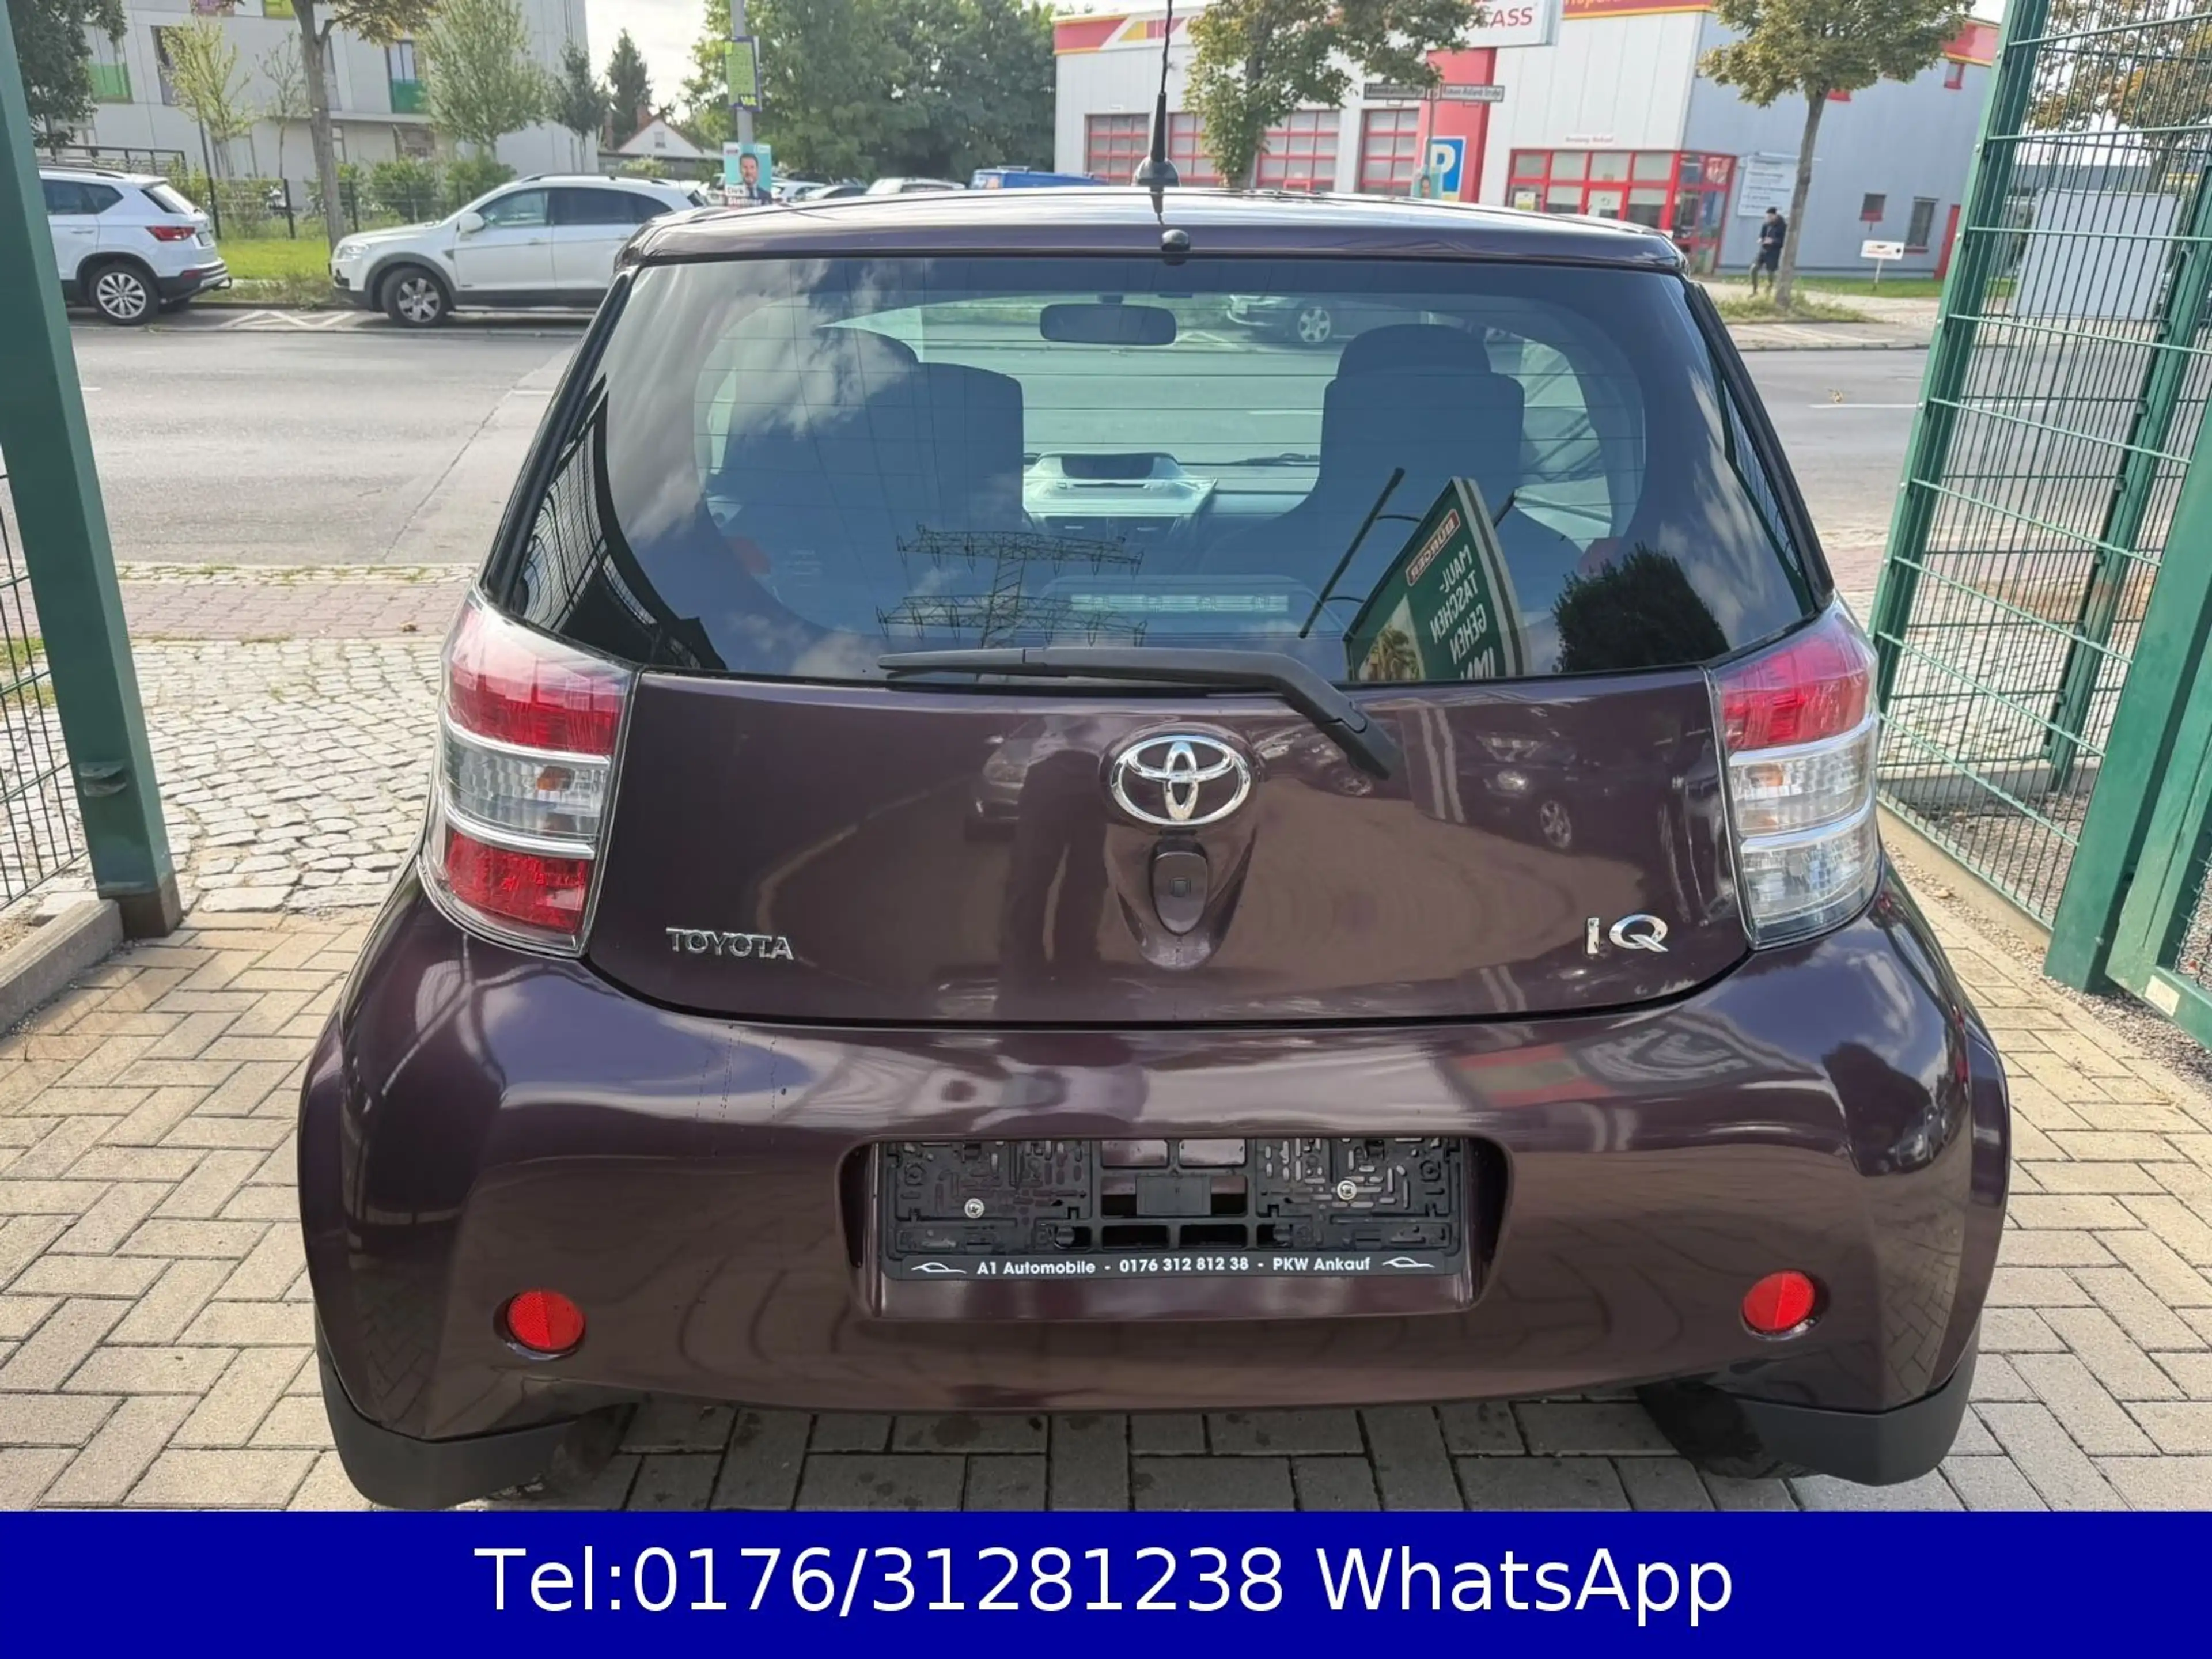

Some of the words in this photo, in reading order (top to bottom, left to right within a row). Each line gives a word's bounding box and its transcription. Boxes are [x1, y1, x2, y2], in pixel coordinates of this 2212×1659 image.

[666, 927, 794, 960] TOYOTA
[1586, 913, 1669, 955] IQ
[976, 1260, 997, 1275] A1
[1002, 1260, 1097, 1275] Automobile
[1119, 1258, 1159, 1273] 0176
[1162, 1257, 1192, 1272] 312
[1196, 1256, 1226, 1271] 812
[1230, 1256, 1250, 1271] 38
[1272, 1257, 1309, 1271] PKW
[1313, 1256, 1371, 1271] Ankauf
